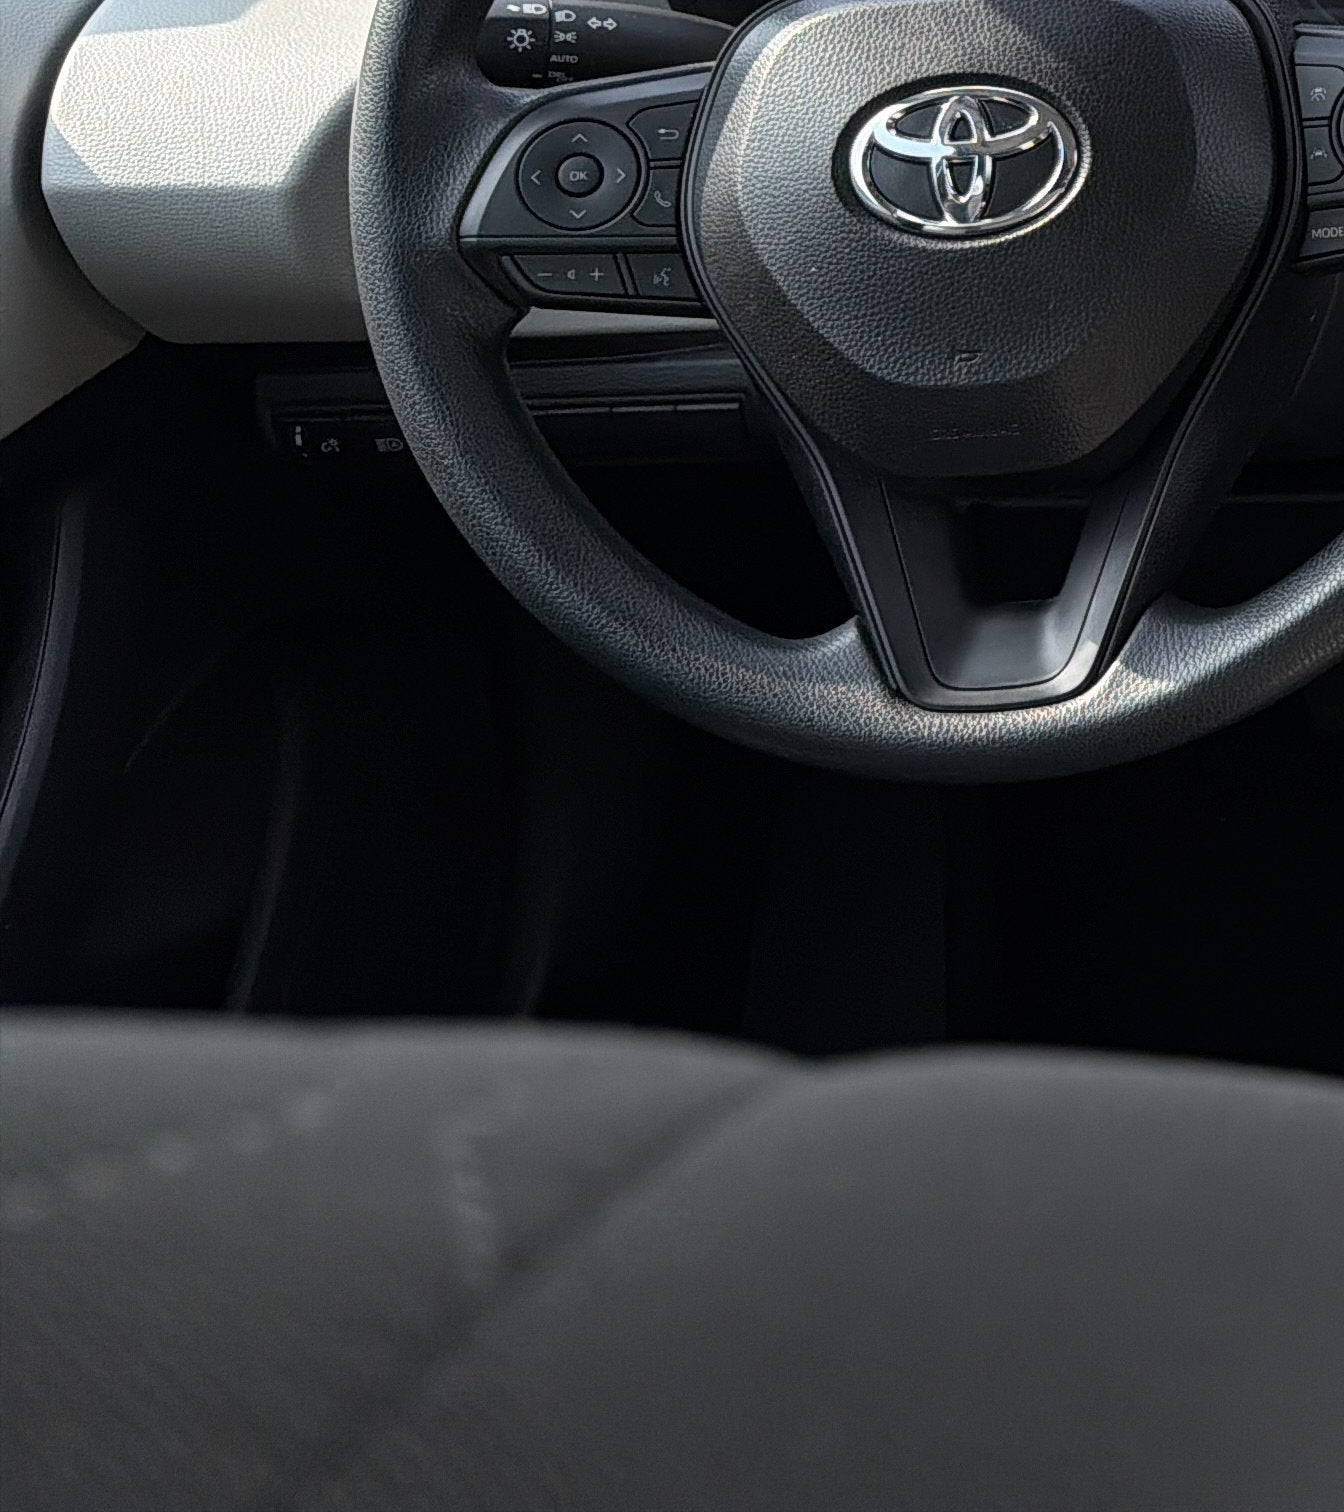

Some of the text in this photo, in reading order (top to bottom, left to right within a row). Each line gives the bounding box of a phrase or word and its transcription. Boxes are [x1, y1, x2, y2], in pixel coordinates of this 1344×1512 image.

[549, 55, 578, 64] AUTO
[569, 170, 589, 181] OK
[1311, 226, 1344, 239] MODE
